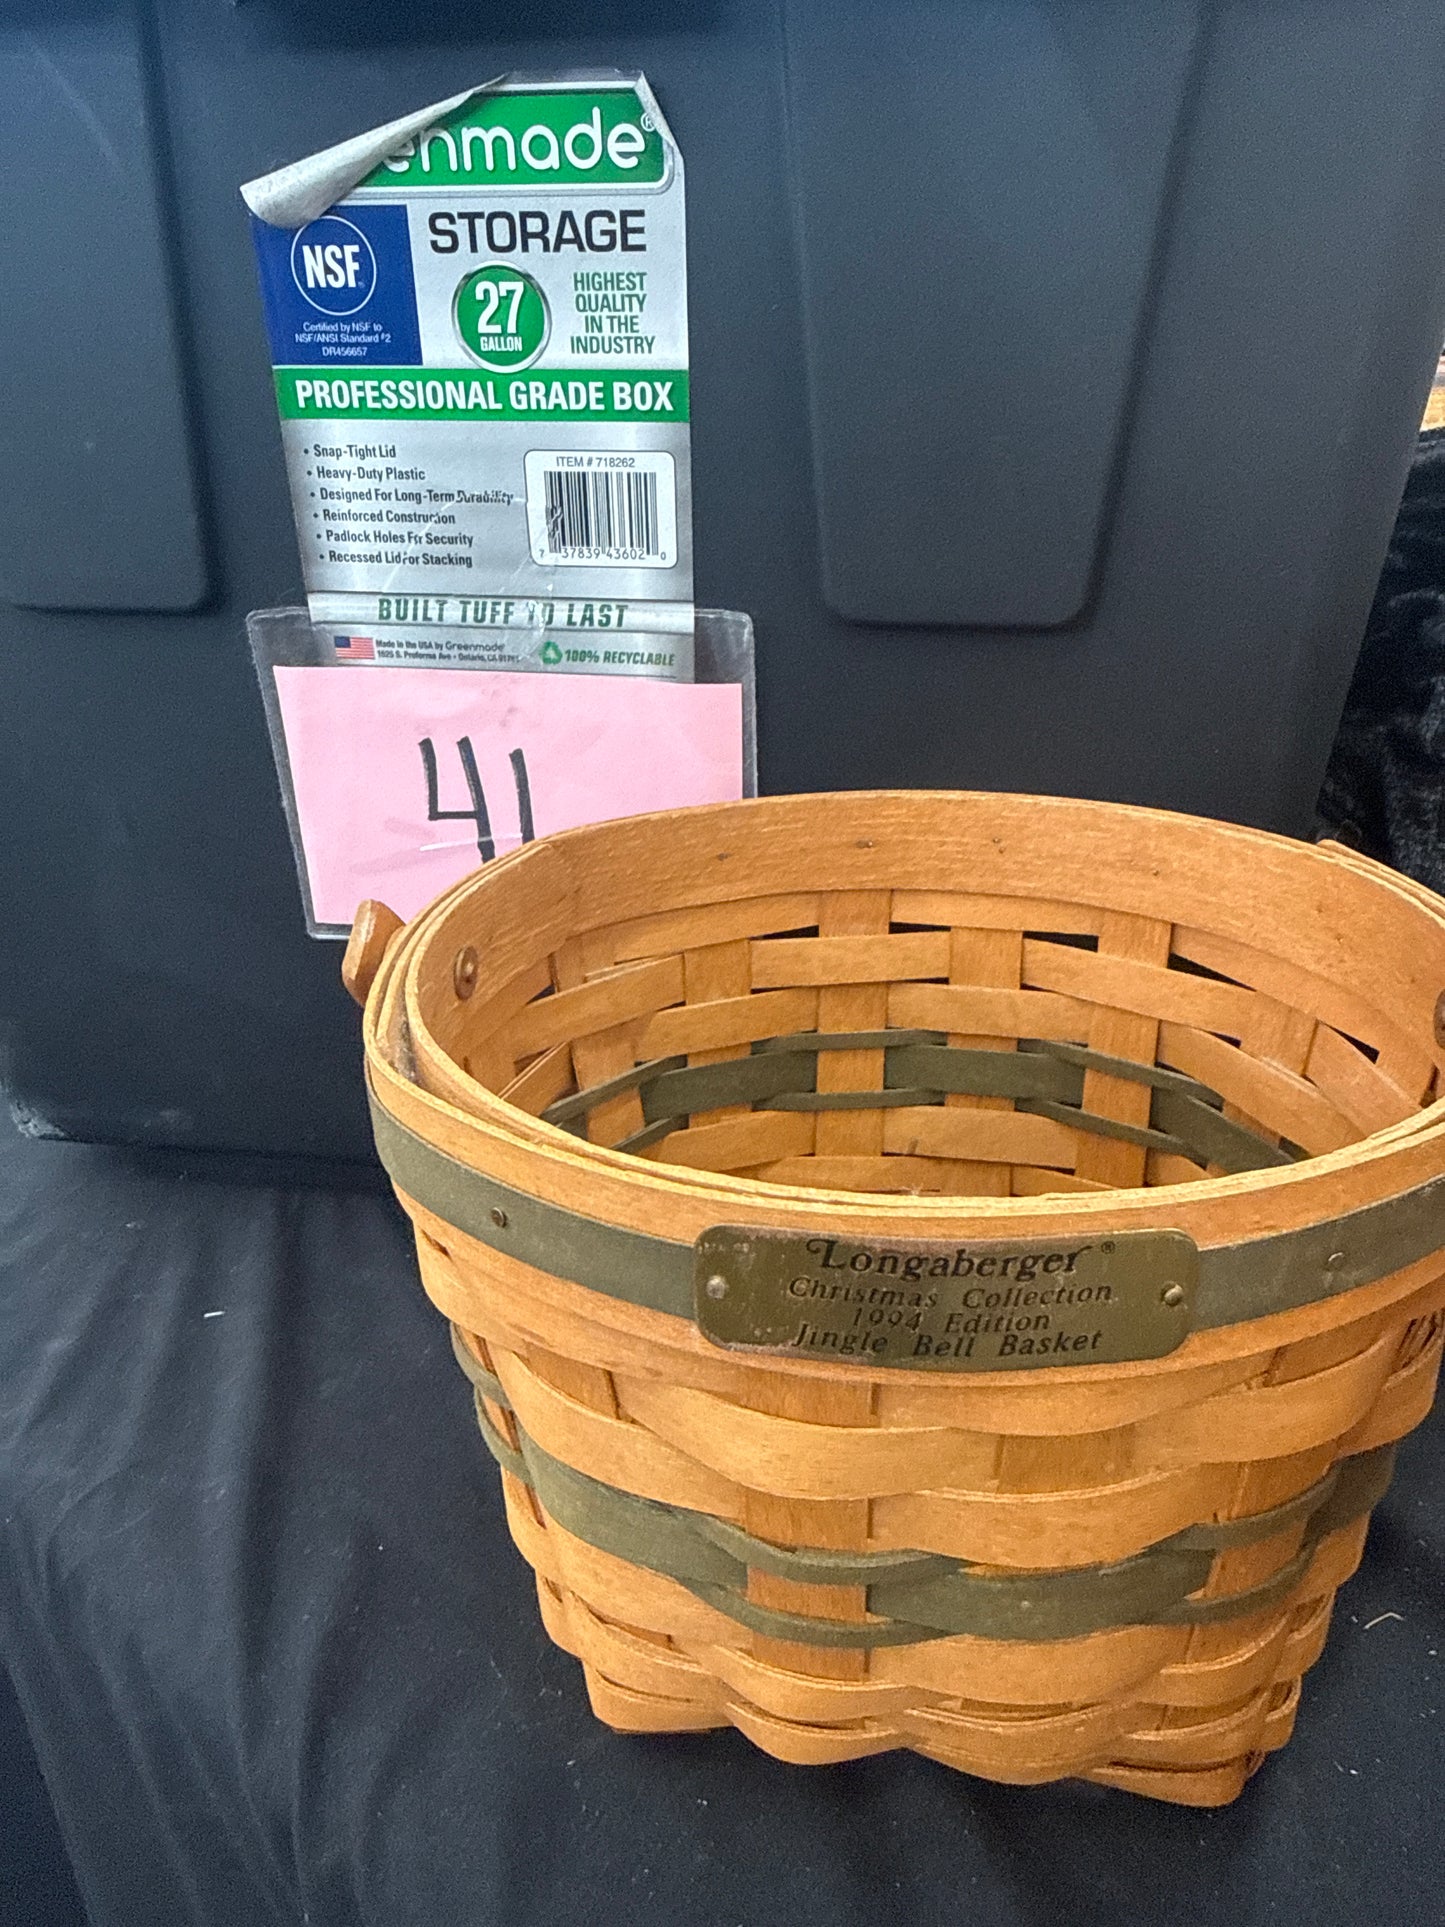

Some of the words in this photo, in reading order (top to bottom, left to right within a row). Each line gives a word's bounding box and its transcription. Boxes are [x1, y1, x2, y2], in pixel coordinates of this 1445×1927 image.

[428, 209, 647, 254] STORAGE
[303, 245, 360, 288] NSF
[573, 272, 648, 292] HIGHEST
[474, 281, 525, 334] 27
[575, 293, 647, 313] QUALITY
[303, 322, 339, 332] Certified
[340, 322, 350, 333] by
[352, 322, 371, 332] NSF
[373, 322, 383, 332] to
[584, 314, 603, 333] IN
[605, 314, 640, 333] THE
[295, 333, 338, 343] NSF/ANSI
[340, 333, 379, 343] Standard
[479, 336, 523, 352] GALLON
[570, 335, 656, 354] INDUSTRY
[295, 379, 502, 411] PROFESSIONAL
[509, 381, 604, 411] GRADE
[613, 382, 674, 411] BOX
[313, 444, 378, 460] Snap-Tight
[379, 445, 397, 458] Lid
[556, 456, 584, 467] ITEM
[587, 457, 594, 467] #
[595, 457, 635, 468] 718262
[316, 466, 384, 482] Heavy-Duty
[385, 466, 426, 480] Plastic
[319, 488, 373, 504] Designed
[374, 488, 392, 500] For
[394, 488, 455, 504] Long-Term
[323, 510, 384, 524] Reinforced
[386, 510, 456, 524] Construction
[326, 529, 372, 544] Padlock
[373, 530, 405, 543] Holes
[407, 531, 423, 545] For
[425, 532, 474, 548] Security
[328, 550, 383, 565] Recessed
[385, 551, 401, 564] Lid
[422, 552, 473, 568] Stacking
[562, 548, 600, 559] 37839
[606, 548, 646, 560] 43602
[660, 551, 667, 561] 0
[378, 599, 447, 623] BUILT
[459, 601, 516, 625] TUFF
[566, 603, 628, 628] LAST
[376, 640, 396, 649] Made
[397, 640, 404, 648] in
[405, 640, 417, 649] the
[418, 641, 433, 649] USA
[435, 641, 443, 650] by
[445, 641, 505, 651] Greenmade
[565, 649, 600, 664] 100%
[603, 650, 675, 666] RECYCLABLE
[418, 736, 535, 863] 41
[806, 1237, 1092, 1282] Longaberger
[789, 1277, 938, 1308] Christmas
[962, 1283, 1113, 1309] Collection
[853, 1307, 922, 1330] 1994
[944, 1312, 1051, 1333] Edition
[793, 1324, 888, 1356] Jingle
[912, 1331, 975, 1357] Bell
[1000, 1330, 1102, 1355] Basket
